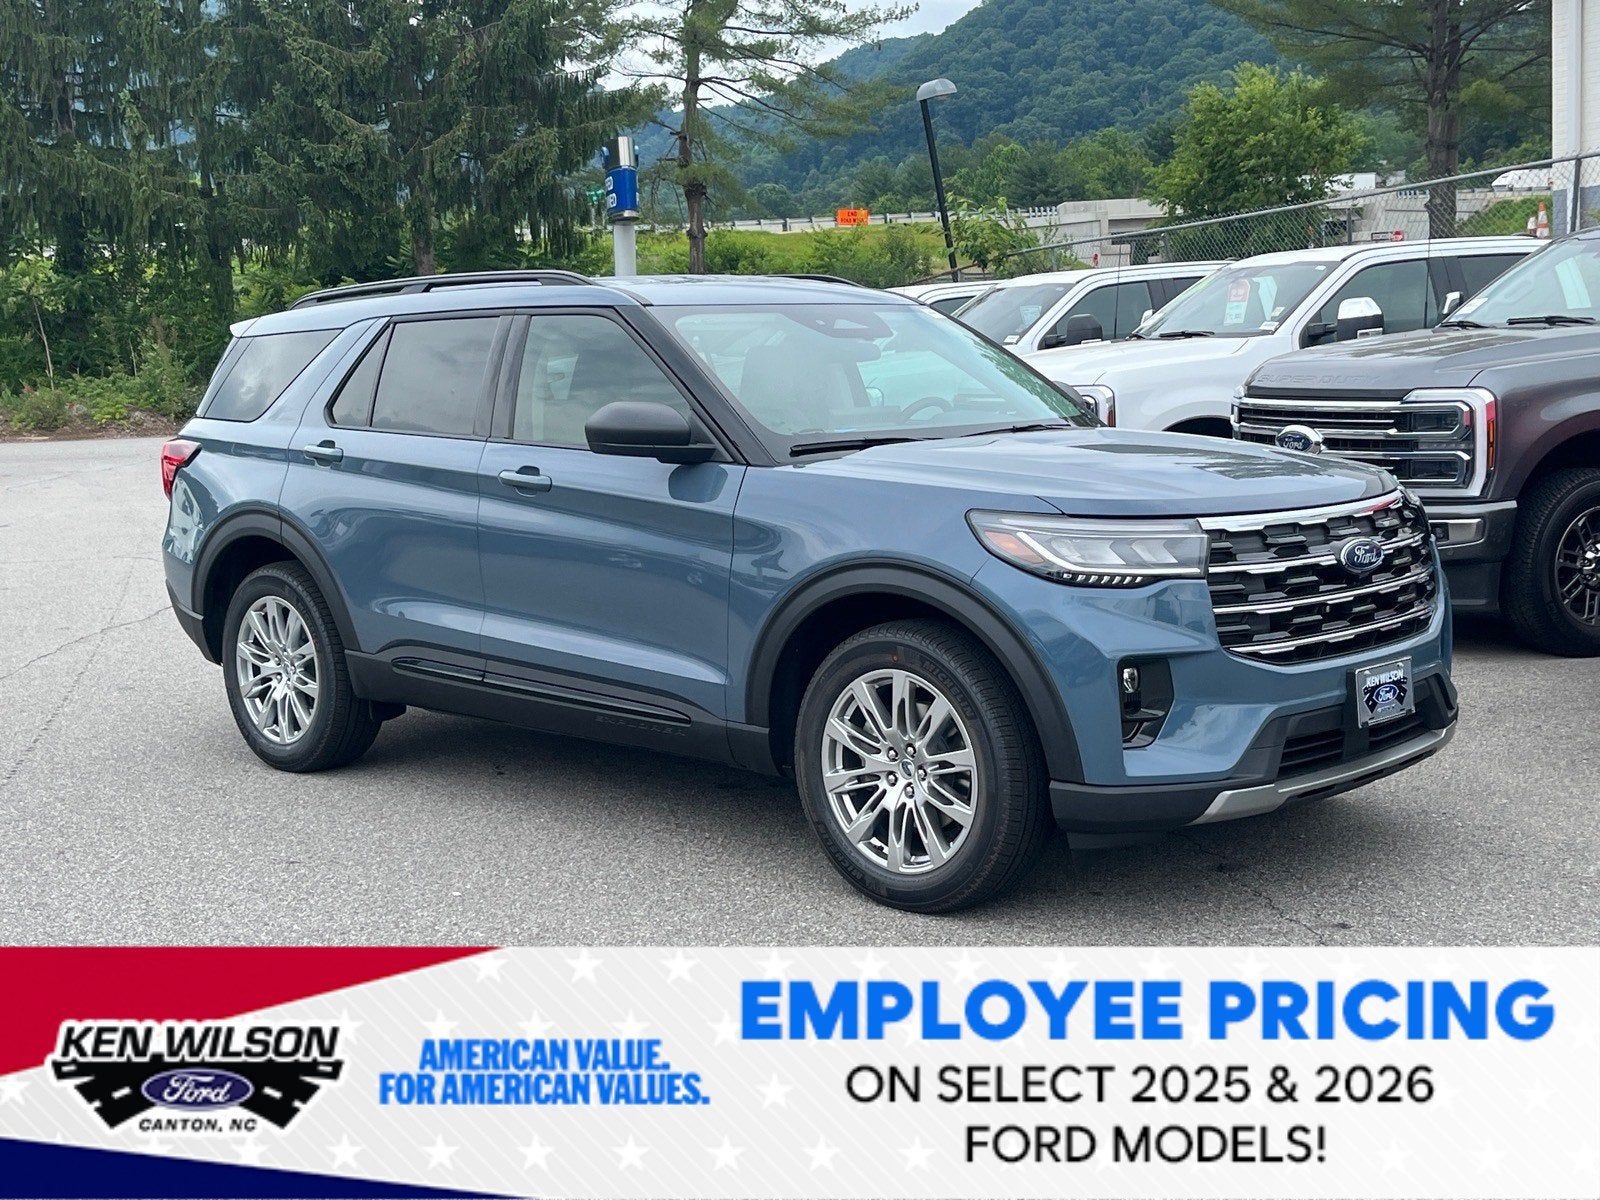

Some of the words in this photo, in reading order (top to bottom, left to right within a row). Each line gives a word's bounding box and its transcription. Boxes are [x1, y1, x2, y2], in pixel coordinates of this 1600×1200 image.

[1353, 544, 1380, 564] Ford
[1366, 674, 1380, 688] KEN
[1380, 668, 1404, 685] WILSON
